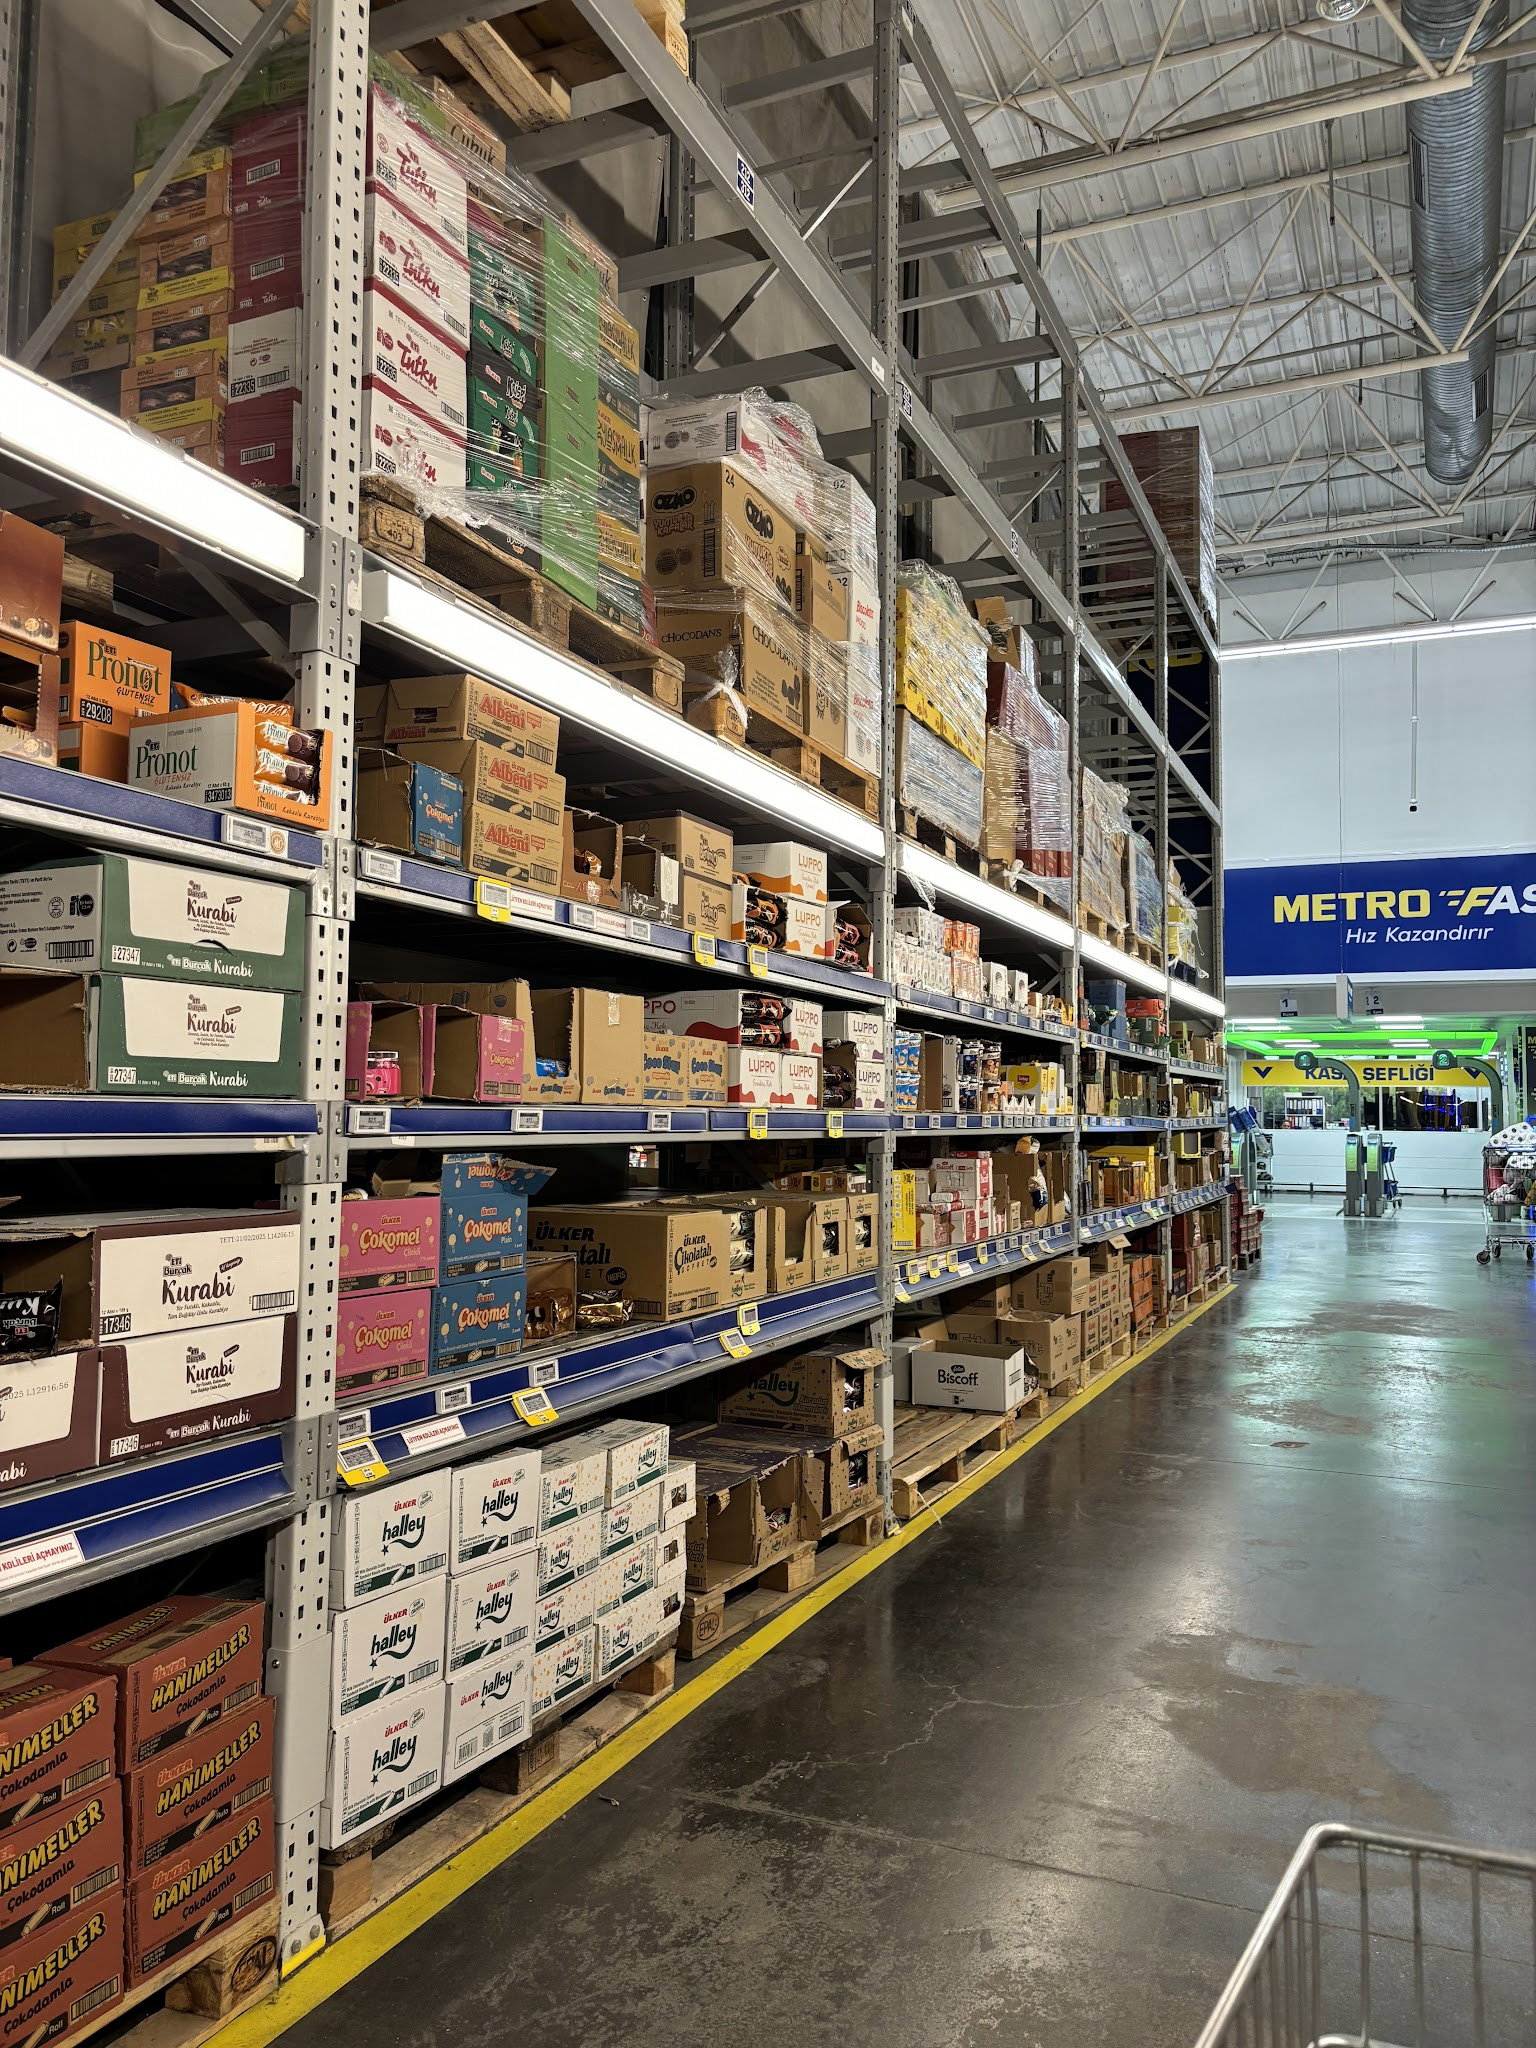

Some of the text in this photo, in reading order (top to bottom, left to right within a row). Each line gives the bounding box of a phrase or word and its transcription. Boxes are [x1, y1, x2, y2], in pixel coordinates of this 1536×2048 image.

[400, 245, 441, 299] Tutku
[397, 340, 438, 390] Tutku
[234, 378, 255, 397] 22335
[725, 470, 735, 488] 24
[654, 488, 695, 510] OZMO
[745, 499, 774, 538] OZMO
[87, 640, 163, 695] Pronot
[116, 686, 155, 704] GLUTENSİZ
[86, 702, 112, 724] 29208
[480, 694, 526, 731] Albeni
[267, 724, 288, 739] Pronot
[387, 726, 425, 739] Albeni
[136, 745, 199, 778] Pronot
[154, 773, 192, 786] GLUTENSİZ
[488, 757, 533, 792] Albeni
[257, 797, 277, 811] Pronot
[485, 822, 530, 854] Albeni
[798, 853, 822, 872] LUPPO
[187, 898, 237, 923] Kurabi
[1273, 889, 1430, 923] METRO
[795, 909, 820, 926] LUPPO
[1345, 925, 1494, 944] Hız Kazandırır
[117, 948, 253, 978] 27347 Burçak Kurabi
[644, 1000, 676, 1014] PPO
[1282, 999, 1288, 1007] 1
[1373, 996, 1380, 1005] 2
[187, 1012, 236, 1034] Kurabi
[795, 1008, 818, 1025] LUPPO
[853, 1020, 878, 1034] LUPPO
[749, 1058, 775, 1073] LUPPO
[1300, 1055, 1310, 1066] 1
[1437, 1054, 1450, 1067] 2
[114, 1067, 248, 1087] 27347 Burçak Kurabi
[790, 1064, 813, 1078] LUPPO
[858, 1070, 881, 1083] LUPPO
[1305, 1063, 1434, 1083] KAS ŞEFLİĞİ
[382, 1216, 401, 1224] ÜLKER
[481, 1207, 497, 1216] ÜLKER
[359, 1226, 421, 1254] Çokomel
[464, 1218, 512, 1243] Çokomel
[501, 1236, 512, 1244] Plain
[536, 1221, 595, 1241] ÜLKER
[684, 1234, 706, 1247] ÜLKER
[674, 1243, 712, 1275] Çikolatalı
[163, 1265, 192, 1277] Burçak
[607, 1269, 627, 1283] NEFİS
[162, 1272, 235, 1305] Kurabi
[477, 1293, 495, 1303] ÜLKER
[104, 1315, 130, 1331] 17346
[376, 1311, 395, 1321] ÜLKER
[458, 1303, 510, 1333] Çokomel
[355, 1320, 413, 1353] Çokomel
[186, 1357, 235, 1384] Kurabi
[116, 1409, 251, 1452] 17346 Burçak Kurabi
[639, 1447, 657, 1462] halley
[493, 1477, 512, 1489] ÜLKER
[482, 1491, 518, 1515] halley
[553, 1486, 573, 1502] halley
[394, 1499, 417, 1511] ÜLKER
[382, 1514, 426, 1541] halley
[610, 1516, 629, 1532] halley
[2, 1553, 35, 1571] KOLİLERİ
[36, 1542, 75, 1561] AÇMAYINIZ
[550, 1549, 570, 1566] halley
[624, 1563, 643, 1580] halley
[486, 1580, 506, 1592] ÜLKER
[476, 1592, 513, 1619] halley
[384, 1609, 408, 1624] ÜLKER
[539, 1610, 560, 1628] halley
[699, 1618, 718, 1634] EPAL
[89, 1605, 176, 1651] HANIMELLER
[371, 1625, 417, 1656] halley
[613, 1630, 630, 1646] halley
[562, 1647, 575, 1657] ÜLKER
[151, 1624, 250, 1711] HANIMELLER
[153, 1657, 187, 1681] ÜLKER
[556, 1656, 579, 1676] halley
[482, 1672, 512, 1696] halley
[176, 1675, 227, 1716] Çokodamla
[460, 1691, 479, 1706] ÜLKER
[206, 1709, 219, 1721] Rulo
[385, 1720, 408, 1737] ÜLKER
[372, 1735, 417, 1771] halley
[1, 1751, 68, 1799] Çokodamla
[157, 1721, 261, 1816] HANIMELLER
[158, 1759, 193, 1786] ÜLKER
[43, 1792, 57, 1805] Roll
[184, 1773, 236, 1818] Çokodamla
[216, 1808, 229, 1819] Rulo
[152, 1859, 190, 1889] ÜLKER
[153, 1816, 261, 1920] HANIMELLER
[8, 1858, 75, 1913] Çokodamla
[183, 1872, 236, 1920] Çokodamla
[51, 1902, 66, 1915] Roll
[0, 1912, 106, 2015] NIMELLER
[4, 1976, 74, 2035] Çokodamla
[49, 2021, 63, 2035] Roll
